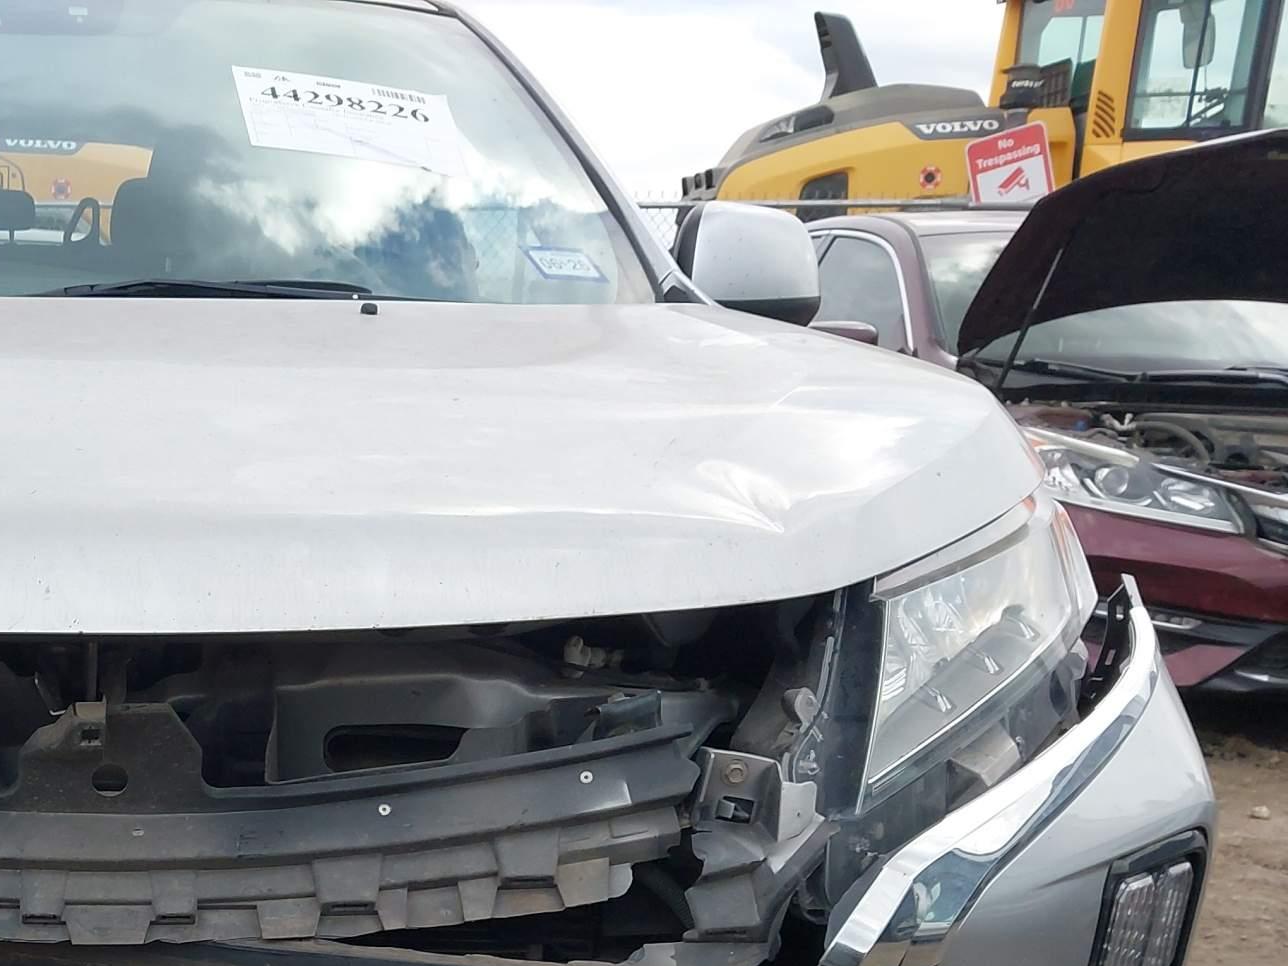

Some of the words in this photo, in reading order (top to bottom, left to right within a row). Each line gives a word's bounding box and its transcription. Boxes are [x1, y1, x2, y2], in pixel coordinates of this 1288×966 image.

[260, 85, 430, 123] 44298226
[915, 119, 1000, 135] VOLVO
[997, 138, 1015, 150] No
[975, 143, 1041, 170] Trespassing
